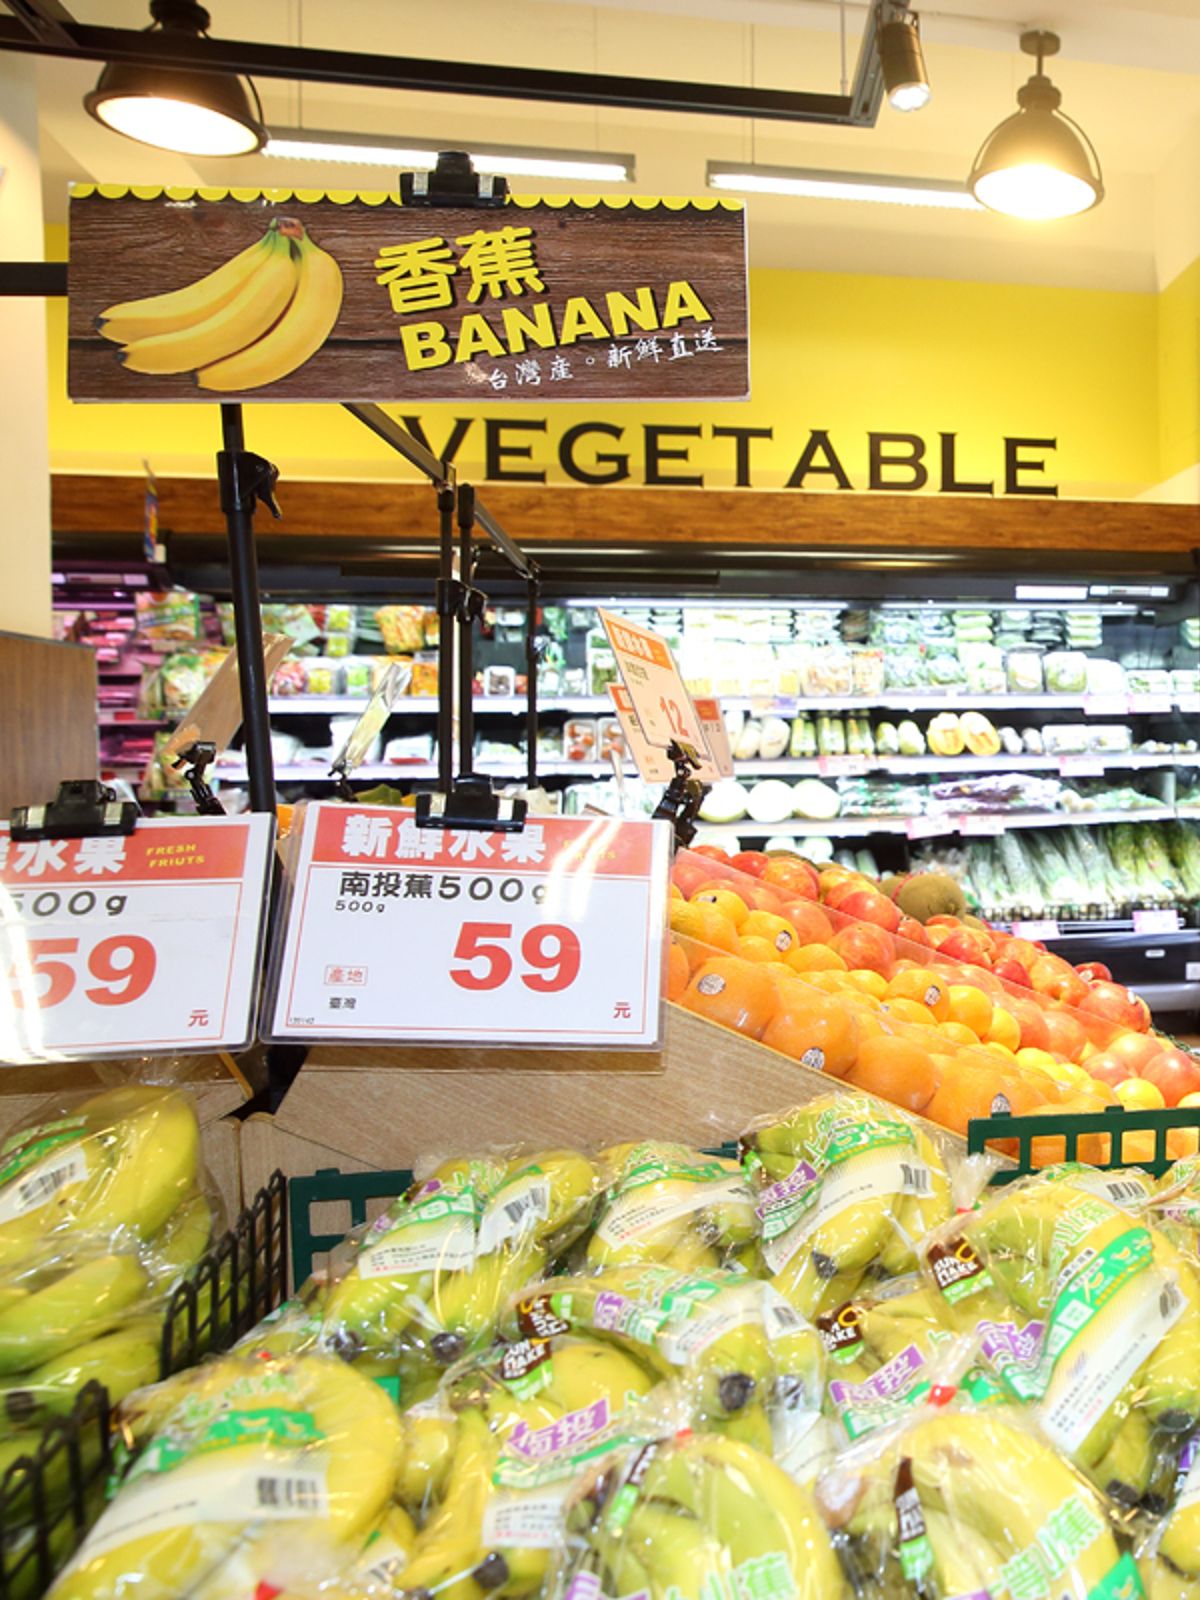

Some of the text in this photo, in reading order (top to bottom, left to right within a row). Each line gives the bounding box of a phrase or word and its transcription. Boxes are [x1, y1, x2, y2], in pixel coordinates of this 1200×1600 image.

[374, 225, 546, 317] 香蕉
[400, 280, 713, 372] BANANA
[402, 415, 1059, 497] VEGETABLE
[659, 695, 689, 738] 12
[0, 836, 128, 876] 水果
[146, 844, 197, 857] FRESH
[341, 814, 547, 864] 新鮮水果
[335, 899, 386, 914] 500g
[12, 935, 157, 1008] 59
[329, 966, 363, 983] 產地
[449, 921, 582, 993] 59
[188, 1009, 209, 1028] 元
[613, 1001, 632, 1019] 元
